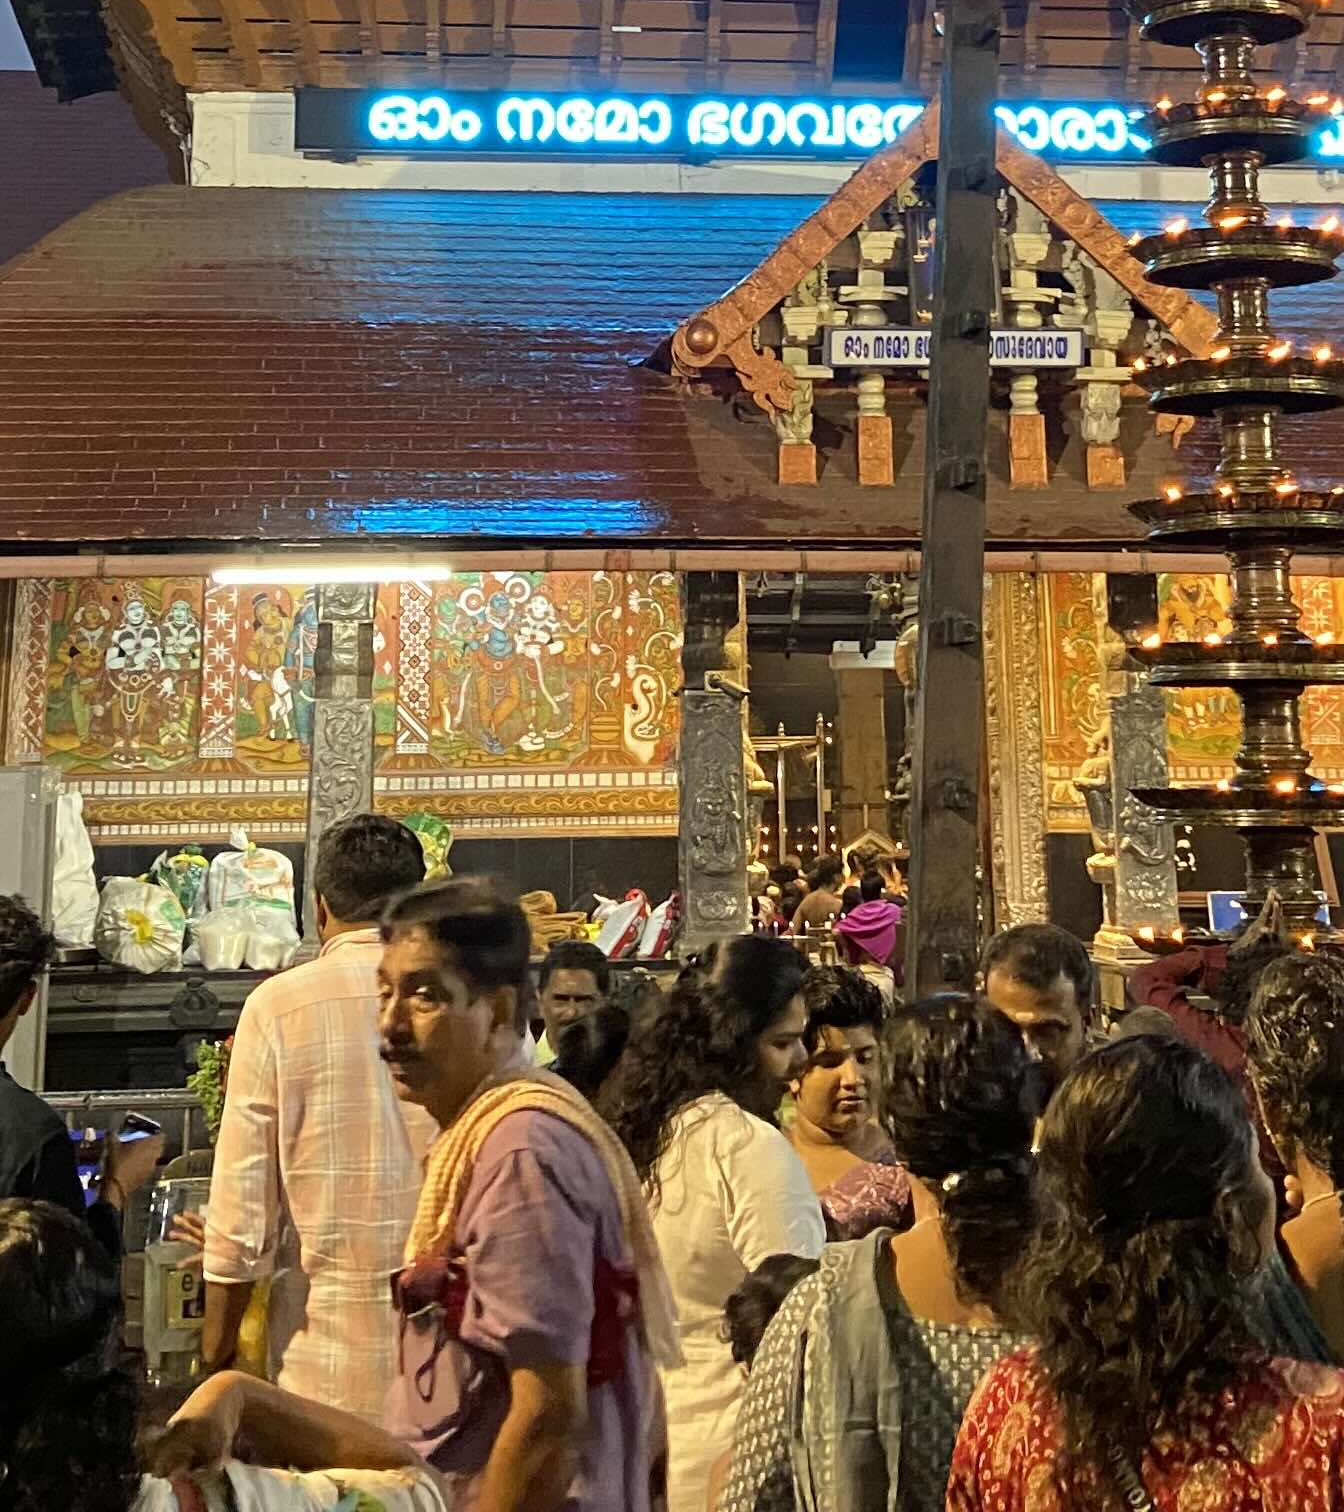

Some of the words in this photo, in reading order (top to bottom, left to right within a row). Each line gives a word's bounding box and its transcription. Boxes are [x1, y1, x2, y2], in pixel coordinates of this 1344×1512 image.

[368, 95, 482, 142] ഓം
[496, 97, 672, 145] നമോ
[844, 335, 869, 359] ഓം
[873, 335, 910, 359] നമോ
[988, 335, 1069, 360] ാസുദേവായ
